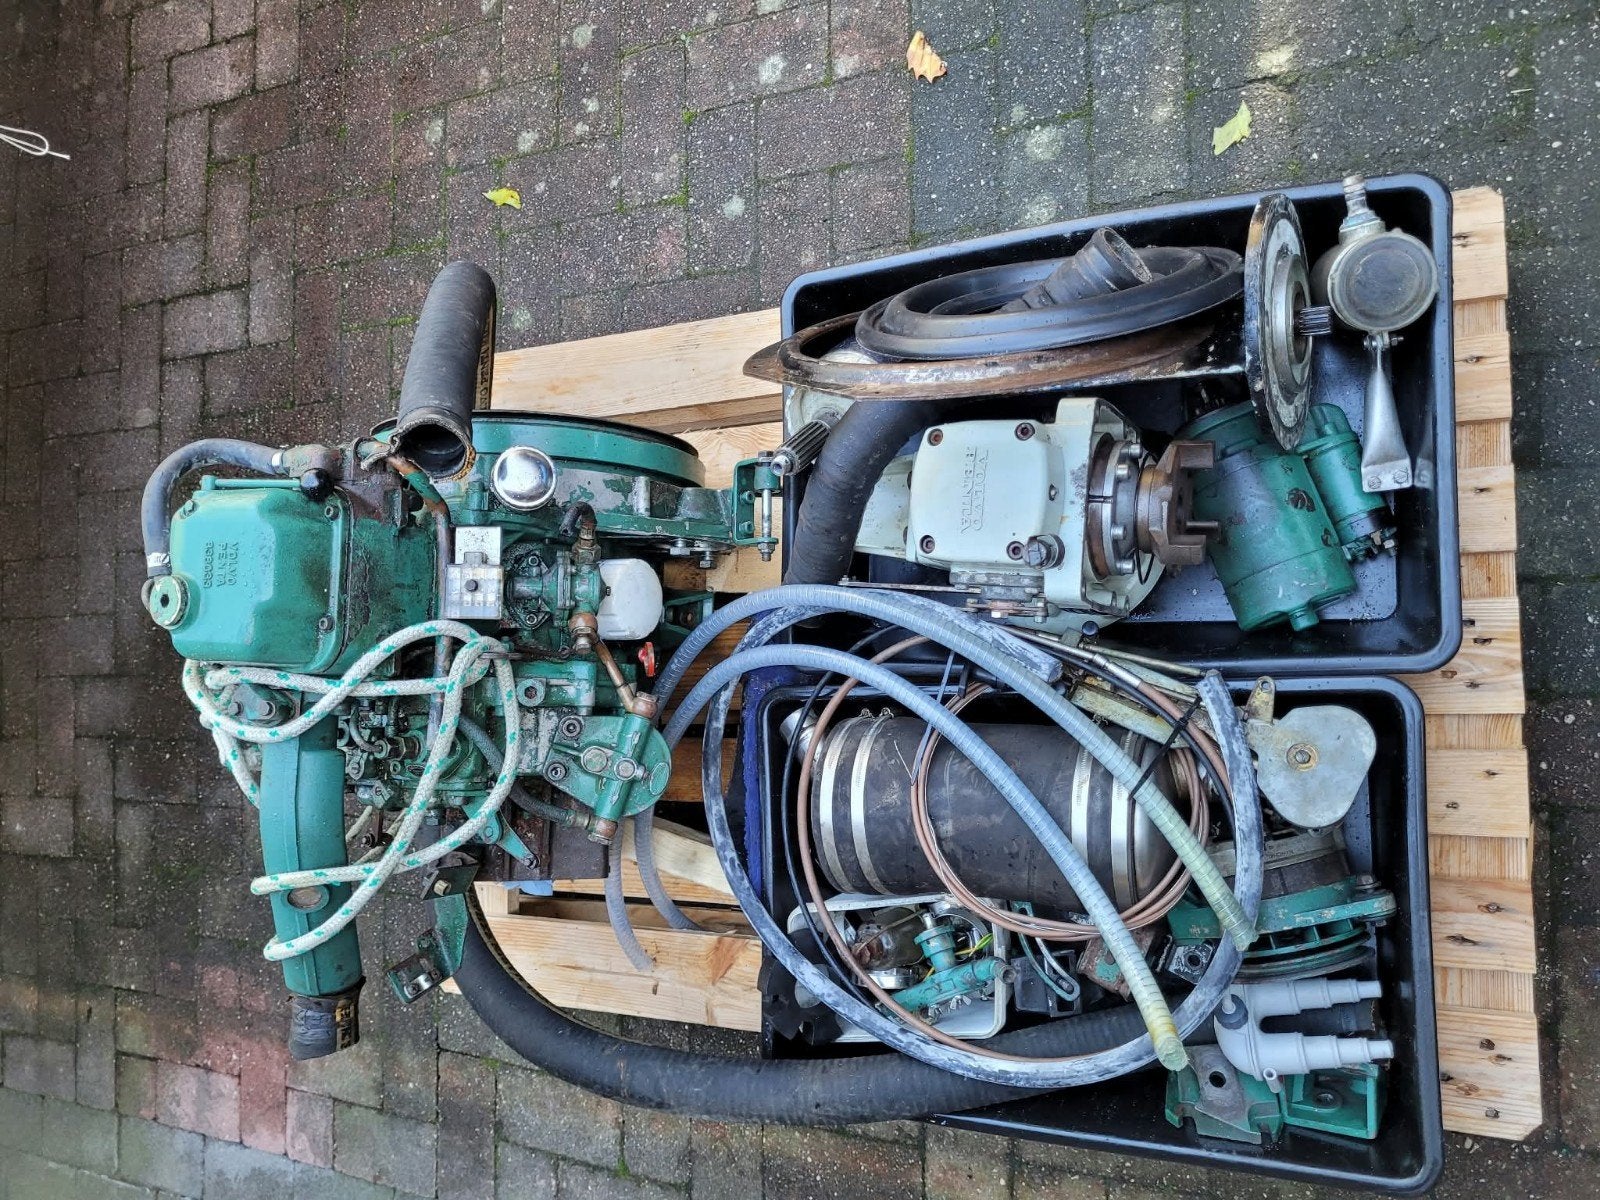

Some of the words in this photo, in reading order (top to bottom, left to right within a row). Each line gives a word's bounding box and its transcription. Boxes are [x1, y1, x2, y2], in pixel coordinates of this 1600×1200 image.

[961, 447, 977, 534] PENTA
[973, 449, 989, 532] VOLVO
[216, 542, 228, 588] PENTA
[227, 541, 239, 586] VOLVO
